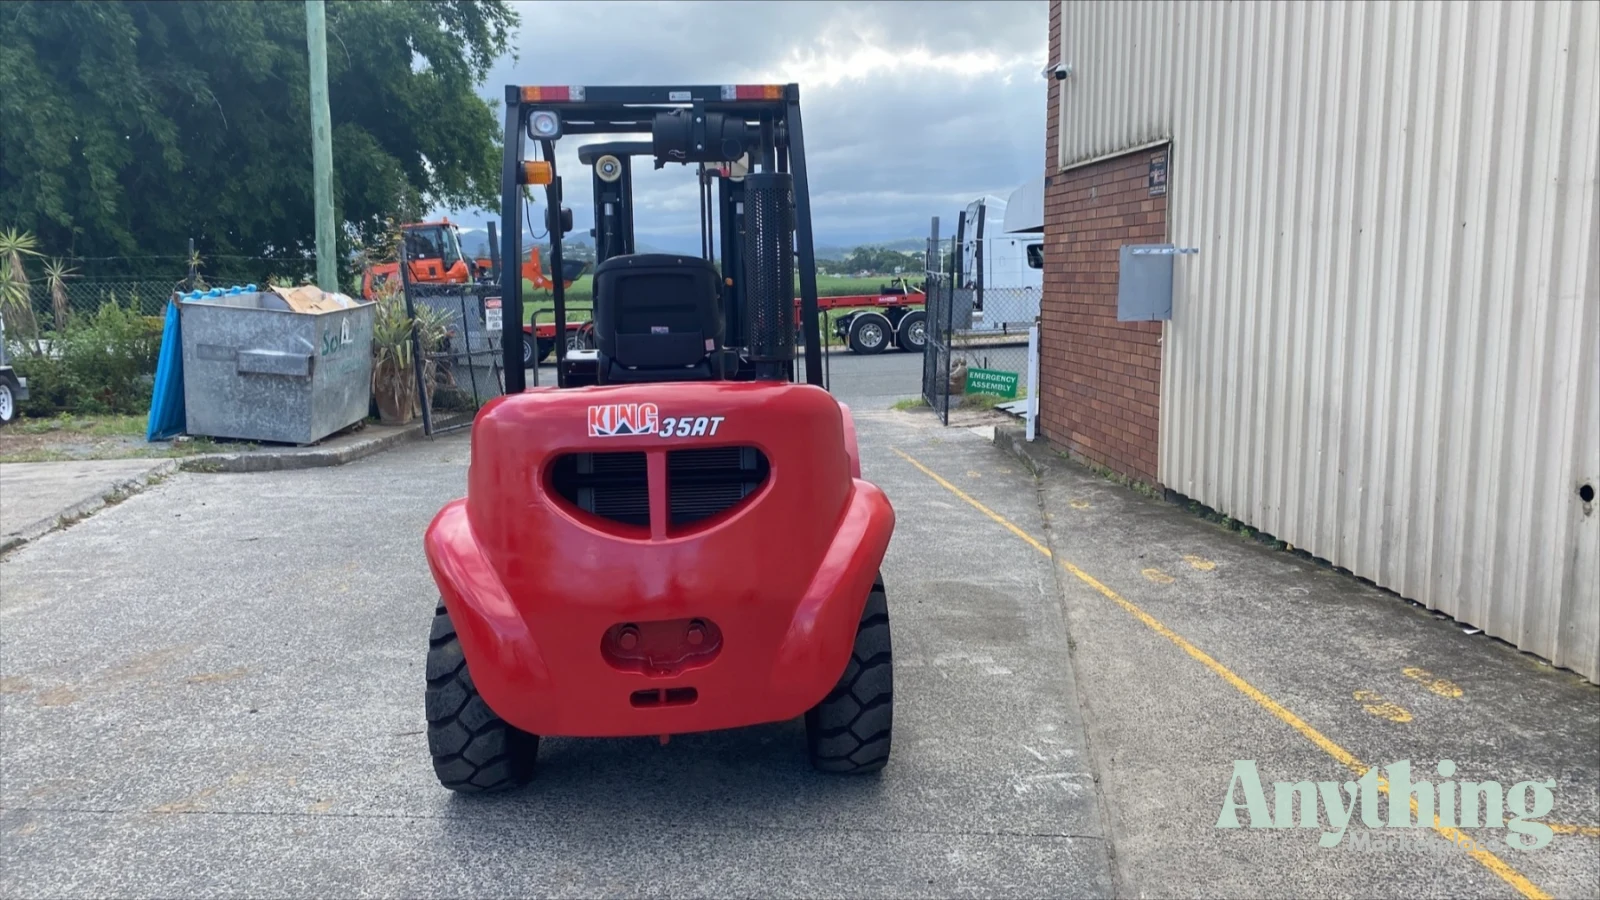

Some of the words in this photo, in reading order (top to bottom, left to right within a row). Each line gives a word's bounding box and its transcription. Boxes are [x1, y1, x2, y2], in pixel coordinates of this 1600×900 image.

[969, 371, 1016, 383] EMERGENCY
[971, 380, 1011, 391] ASSEMBLY
[588, 403, 658, 437] KING
[659, 417, 725, 437] 35AT
